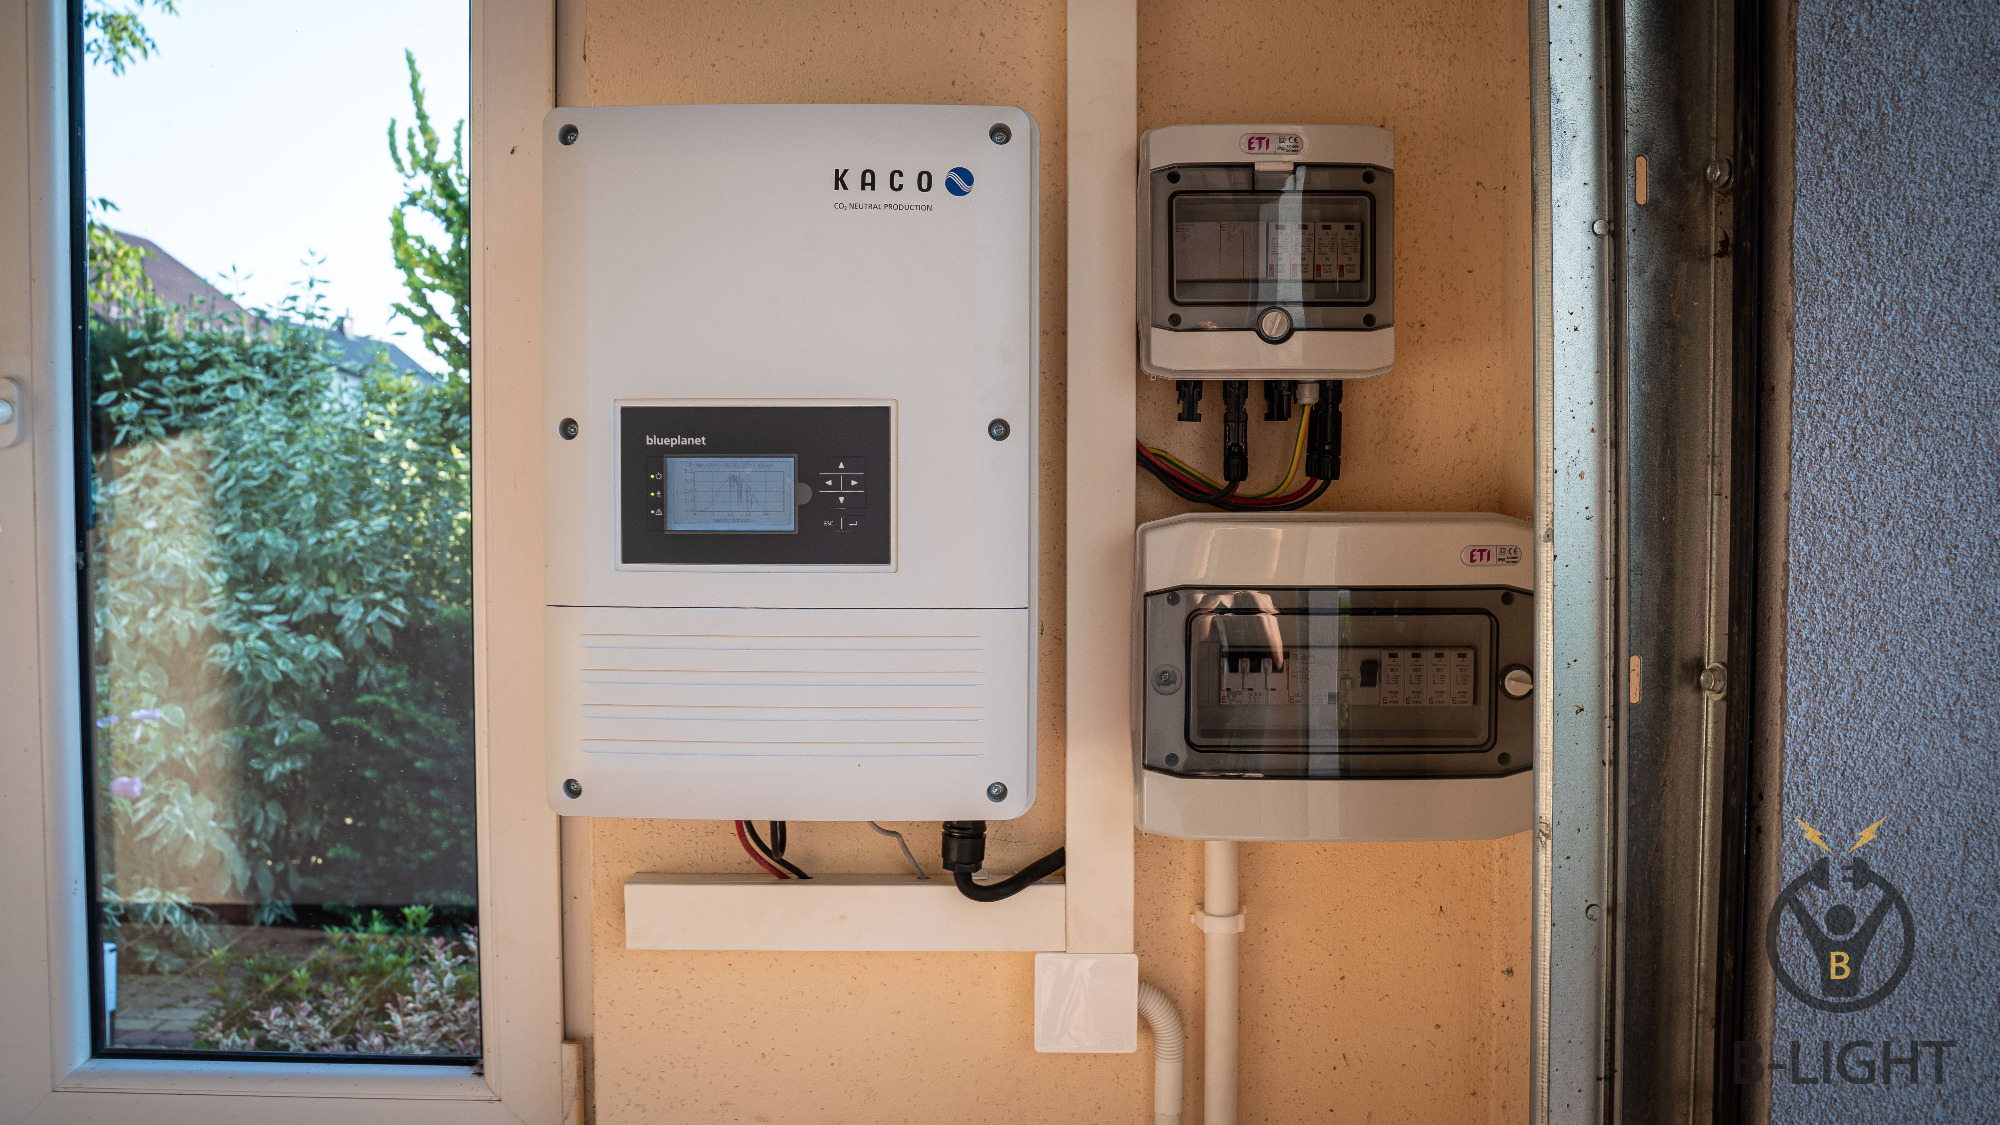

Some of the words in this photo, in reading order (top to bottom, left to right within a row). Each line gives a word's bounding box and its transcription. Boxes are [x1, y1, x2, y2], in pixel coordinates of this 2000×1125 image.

[1247, 136, 1270, 151] ETI
[834, 168, 933, 193] KACO
[849, 202, 882, 210] NEUTRAL
[884, 203, 933, 211] PRODUCTION
[646, 435, 707, 447] blueplanet
[1469, 548, 1491, 563] ETI
